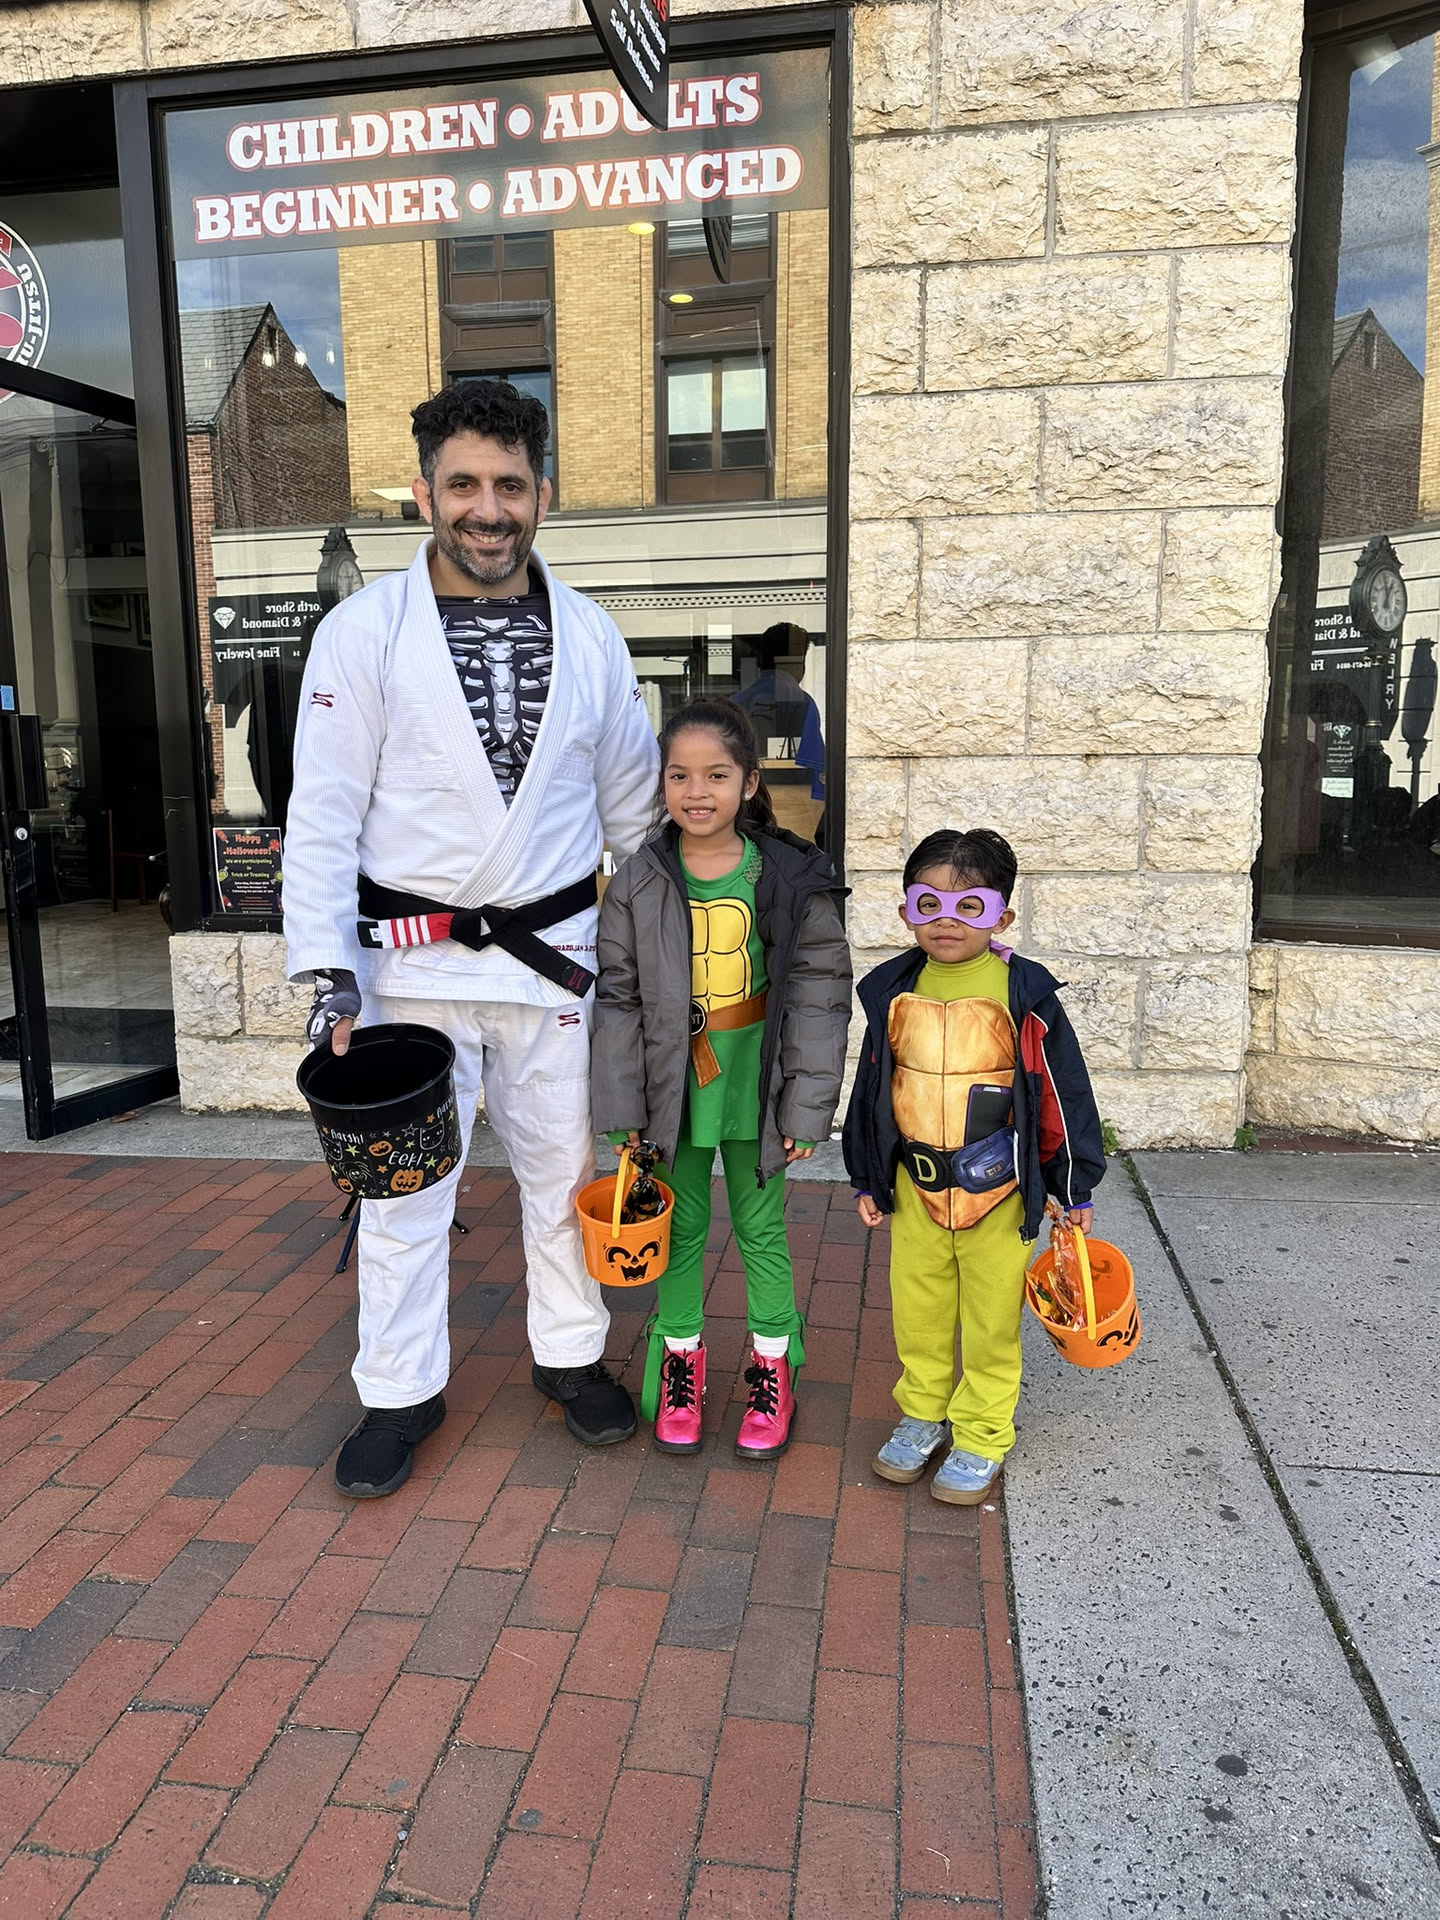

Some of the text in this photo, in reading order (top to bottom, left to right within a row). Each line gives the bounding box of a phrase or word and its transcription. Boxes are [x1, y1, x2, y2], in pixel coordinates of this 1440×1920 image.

[610, 8, 627, 44] Self
[626, 35, 654, 94] Defense
[227, 99, 500, 172] CHILDREN
[194, 145, 804, 243] BEGINNER ADVANCED
[15, 263, 43, 366] IU-JITSU
[235, 833, 261, 845] Happy
[912, 1152, 937, 1183] D
